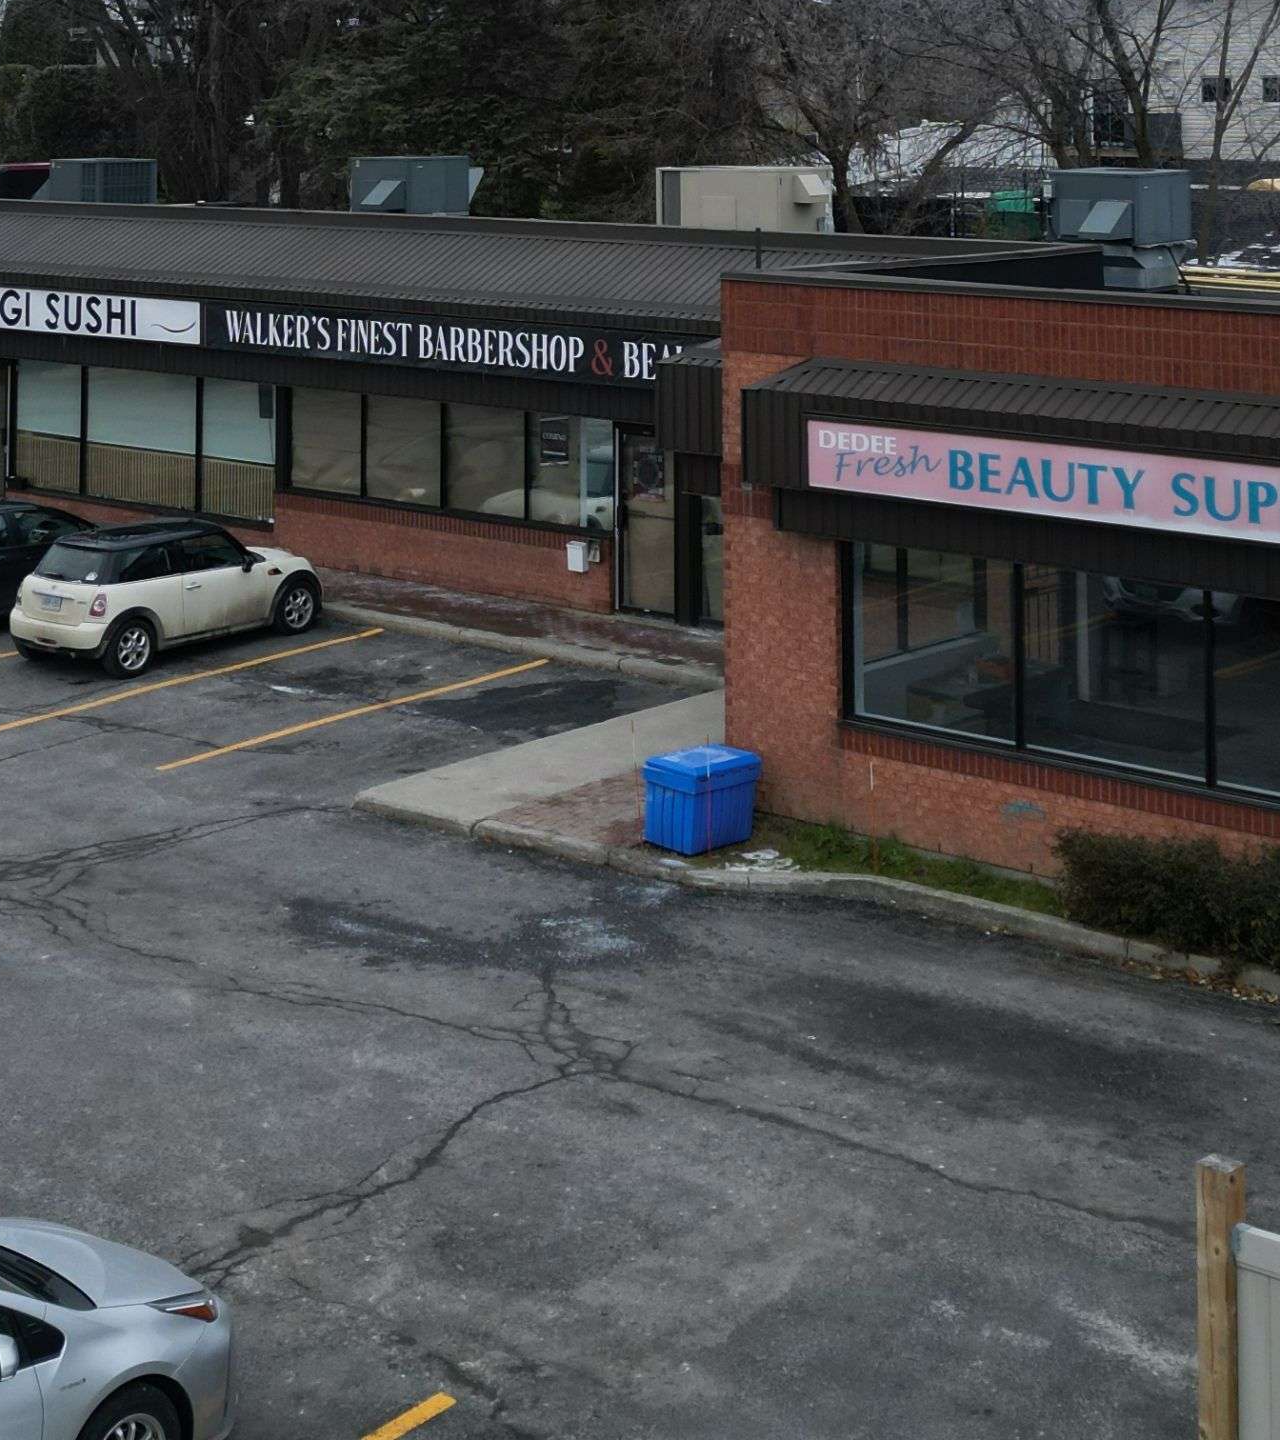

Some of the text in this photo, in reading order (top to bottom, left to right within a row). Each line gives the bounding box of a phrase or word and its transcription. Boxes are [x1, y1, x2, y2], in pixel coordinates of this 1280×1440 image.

[45, 292, 137, 336] SUSHI
[225, 310, 330, 351] WALKER'S
[336, 318, 413, 357] FINEST
[419, 324, 585, 372] BARBERSHOP
[591, 338, 614, 376] &
[818, 429, 897, 456] DEDEE
[834, 444, 942, 482] Fresh
[948, 449, 1144, 510] BEAUTY
